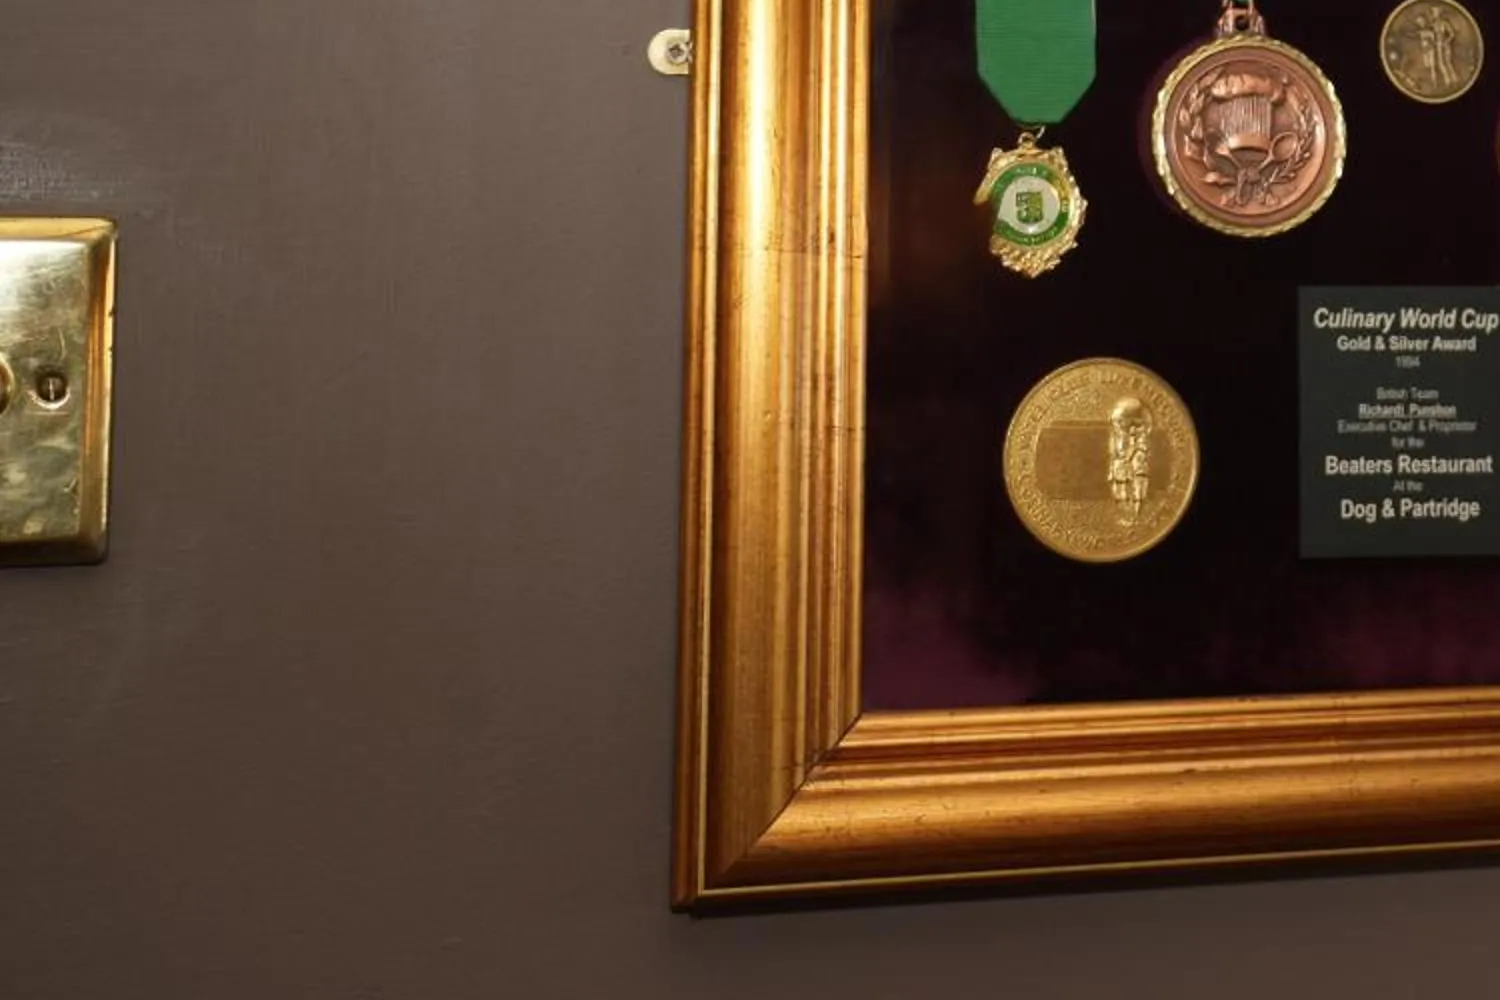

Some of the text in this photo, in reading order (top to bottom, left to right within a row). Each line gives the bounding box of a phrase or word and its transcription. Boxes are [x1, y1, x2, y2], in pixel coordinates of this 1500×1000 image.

[1313, 307, 1500, 334] Culinary World Cup
[1336, 335, 1478, 352] Gold & Silver Award
[1410, 387, 1440, 400] Team
[1337, 419, 1387, 434] Executive
[1389, 419, 1415, 432] Chef
[1417, 420, 1427, 432] &
[1391, 436, 1425, 449] for the
[1325, 454, 1494, 475] Beaters Restaurant
[1392, 479, 1424, 493] At the
[1340, 498, 1481, 524] Dog & Partridge
